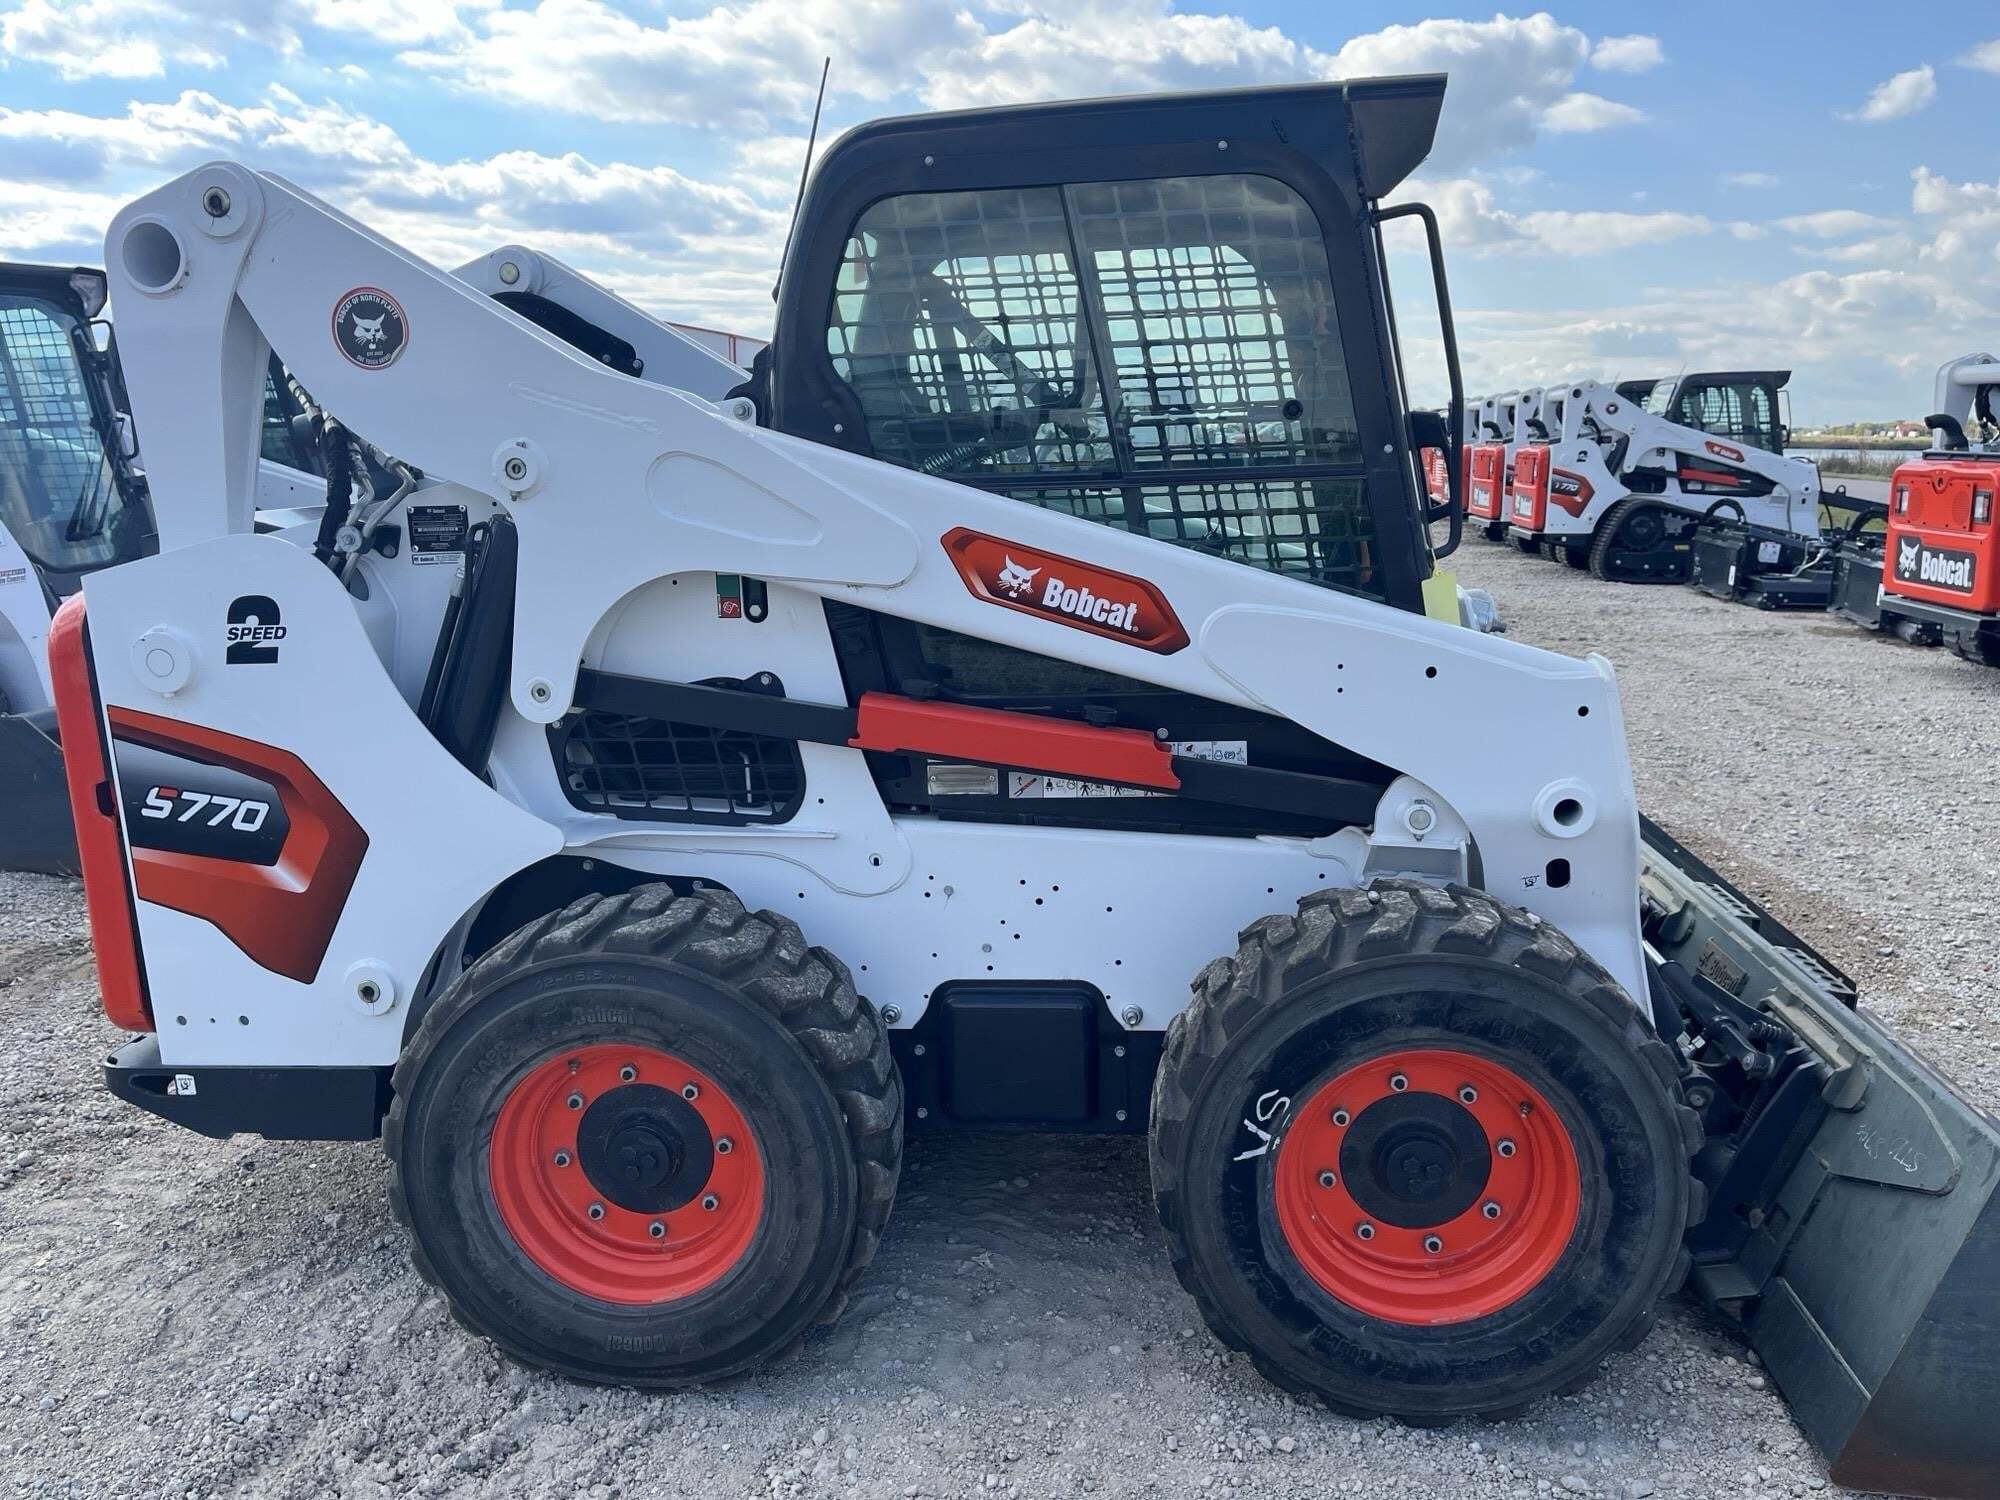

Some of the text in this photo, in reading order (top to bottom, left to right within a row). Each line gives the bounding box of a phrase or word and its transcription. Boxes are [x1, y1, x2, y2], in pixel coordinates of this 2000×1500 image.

[337, 301, 353, 323] BOBCAT
[360, 295, 381, 304] NORTH
[380, 300, 400, 320] PLATTE
[1920, 550, 1971, 588] Bobcat
[1042, 577, 1138, 631] Bobcat
[226, 594, 281, 665] 2
[226, 626, 288, 641] SPEED
[140, 786, 271, 833] S770
